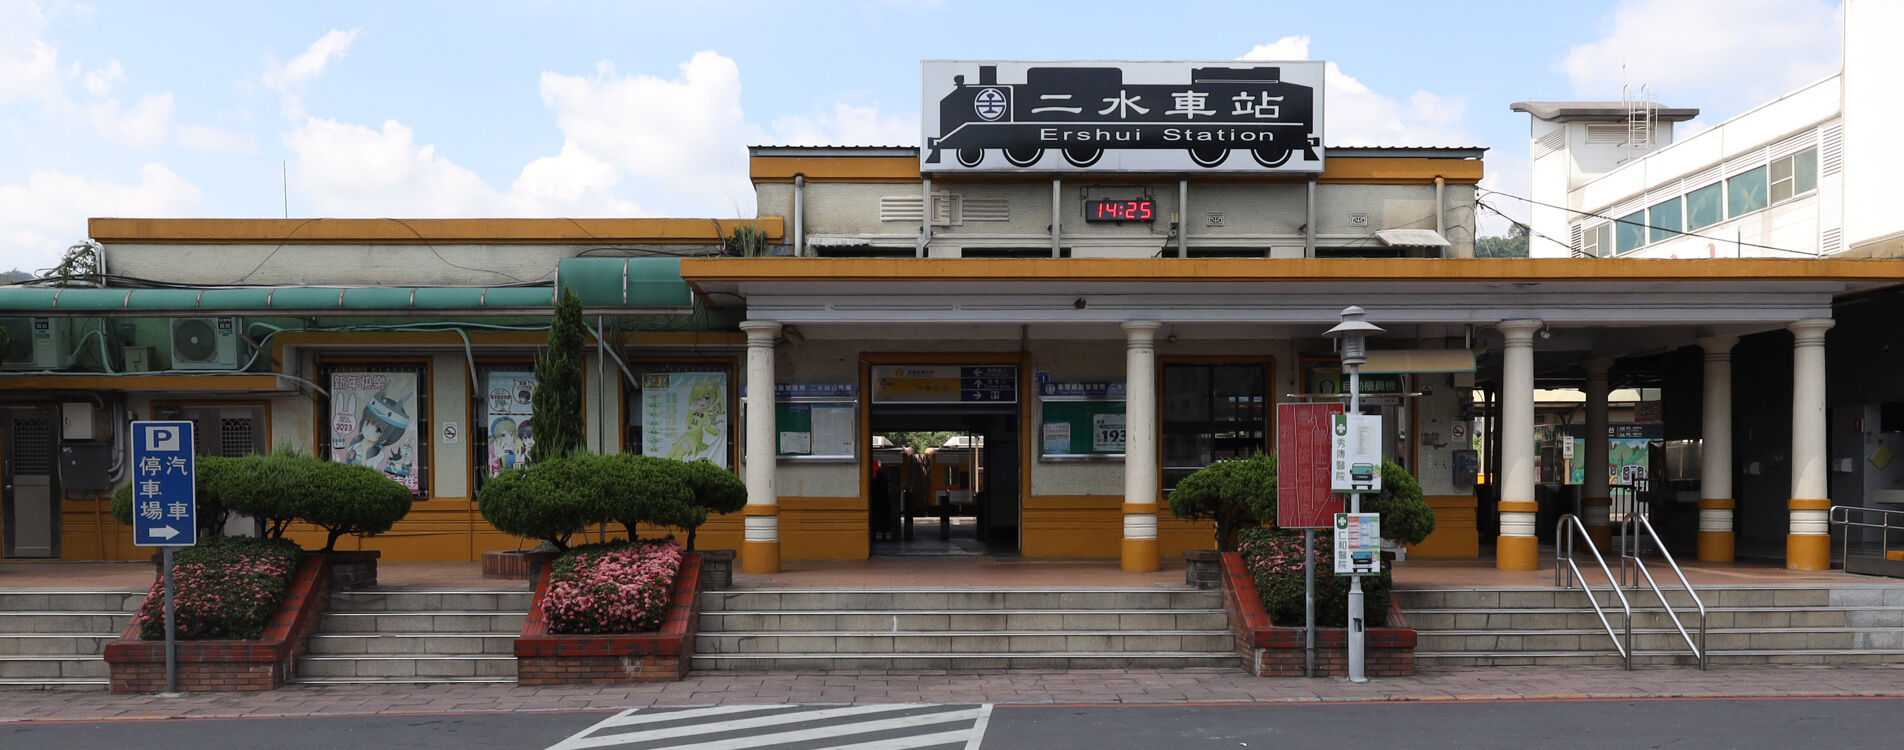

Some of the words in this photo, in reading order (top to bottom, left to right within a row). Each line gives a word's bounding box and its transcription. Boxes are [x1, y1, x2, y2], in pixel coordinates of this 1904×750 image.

[1031, 89, 1285, 120] 二水車站
[1040, 128, 1141, 141] Ershui
[1163, 128, 1274, 141] Station
[1097, 202, 1153, 219] 14:25
[333, 374, 387, 391] 新年快樂
[775, 384, 806, 392] 路管理局
[336, 423, 353, 432] 2023
[153, 430, 172, 448] P
[139, 456, 163, 521] 停車場
[166, 456, 189, 520] 汽車
[1338, 531, 1347, 570] 仁和醫院
